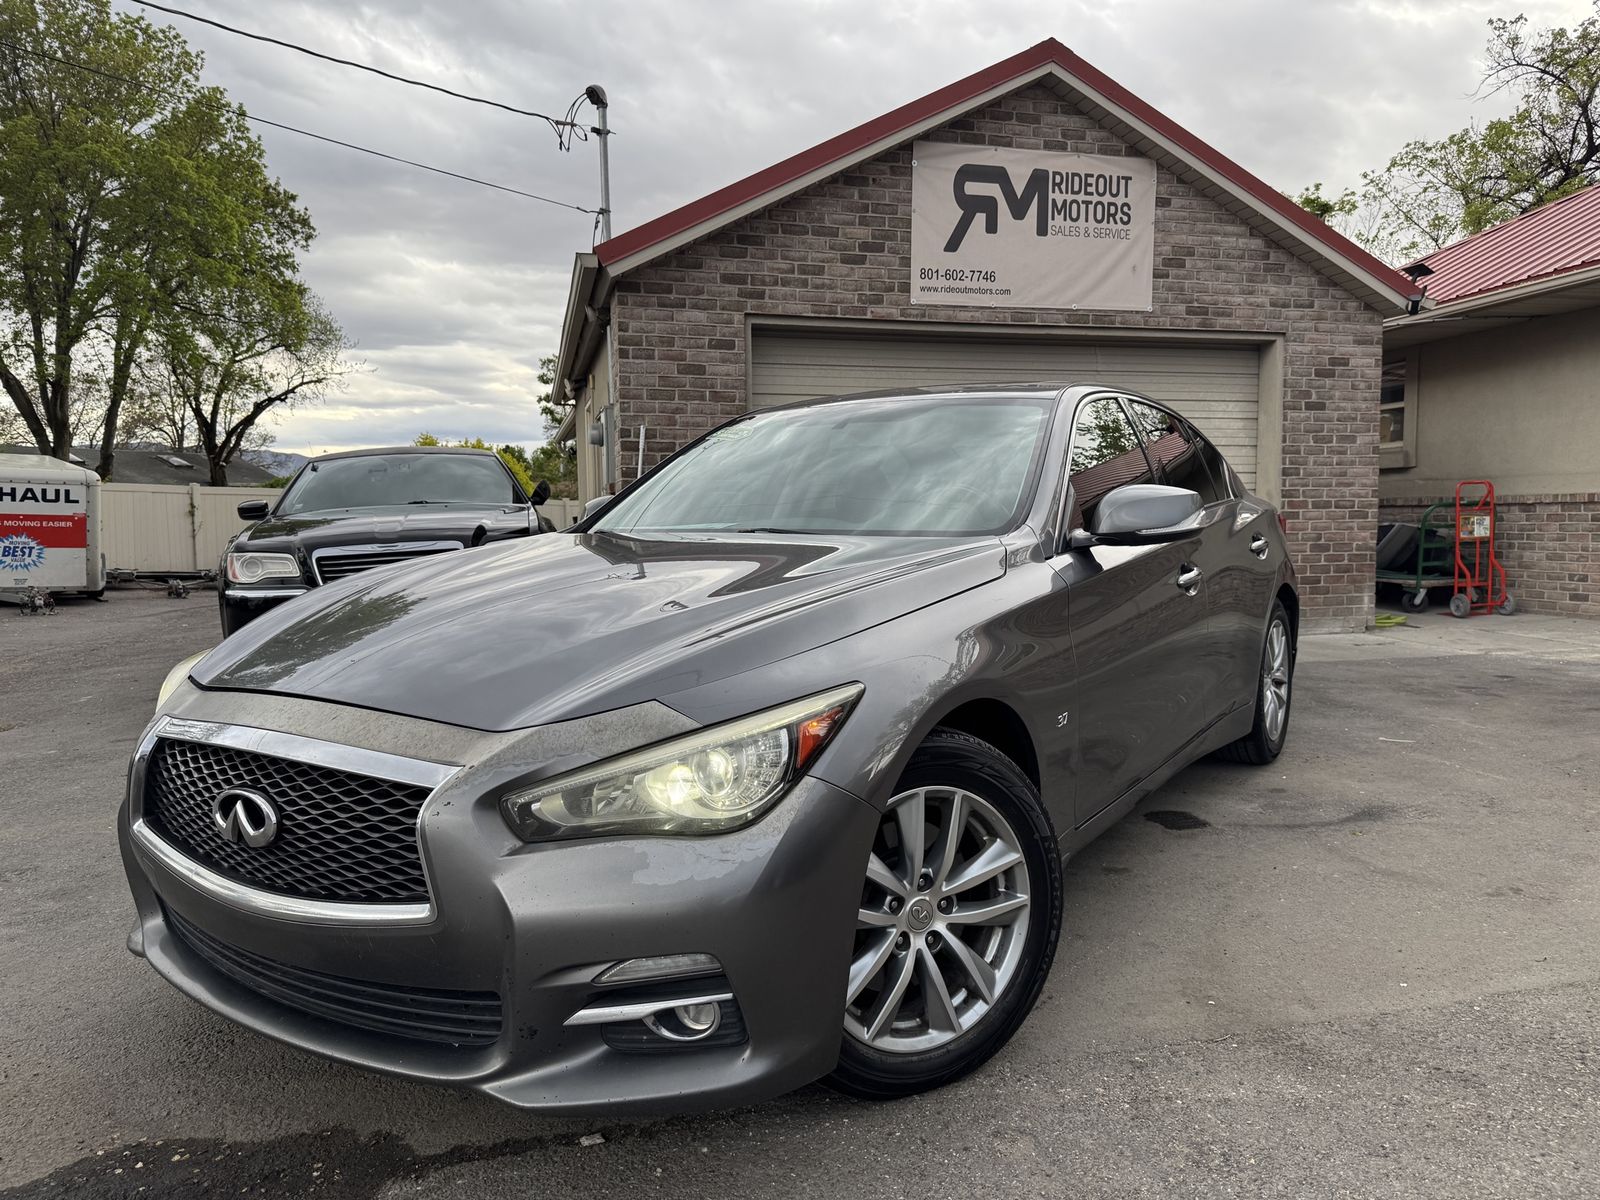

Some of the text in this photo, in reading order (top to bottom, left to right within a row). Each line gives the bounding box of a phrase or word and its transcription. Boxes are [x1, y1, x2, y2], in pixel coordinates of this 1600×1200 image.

[1051, 170, 1133, 199] RIDEOUT
[1051, 198, 1132, 226] MOTORS
[1050, 225, 1131, 240] SALES & SERVICE
[919, 267, 997, 283] 801-602-7746
[919, 284, 1011, 296] www.rideoutmotors.com
[0, 487, 79, 504] HAUL
[1, 546, 35, 558] BEST
